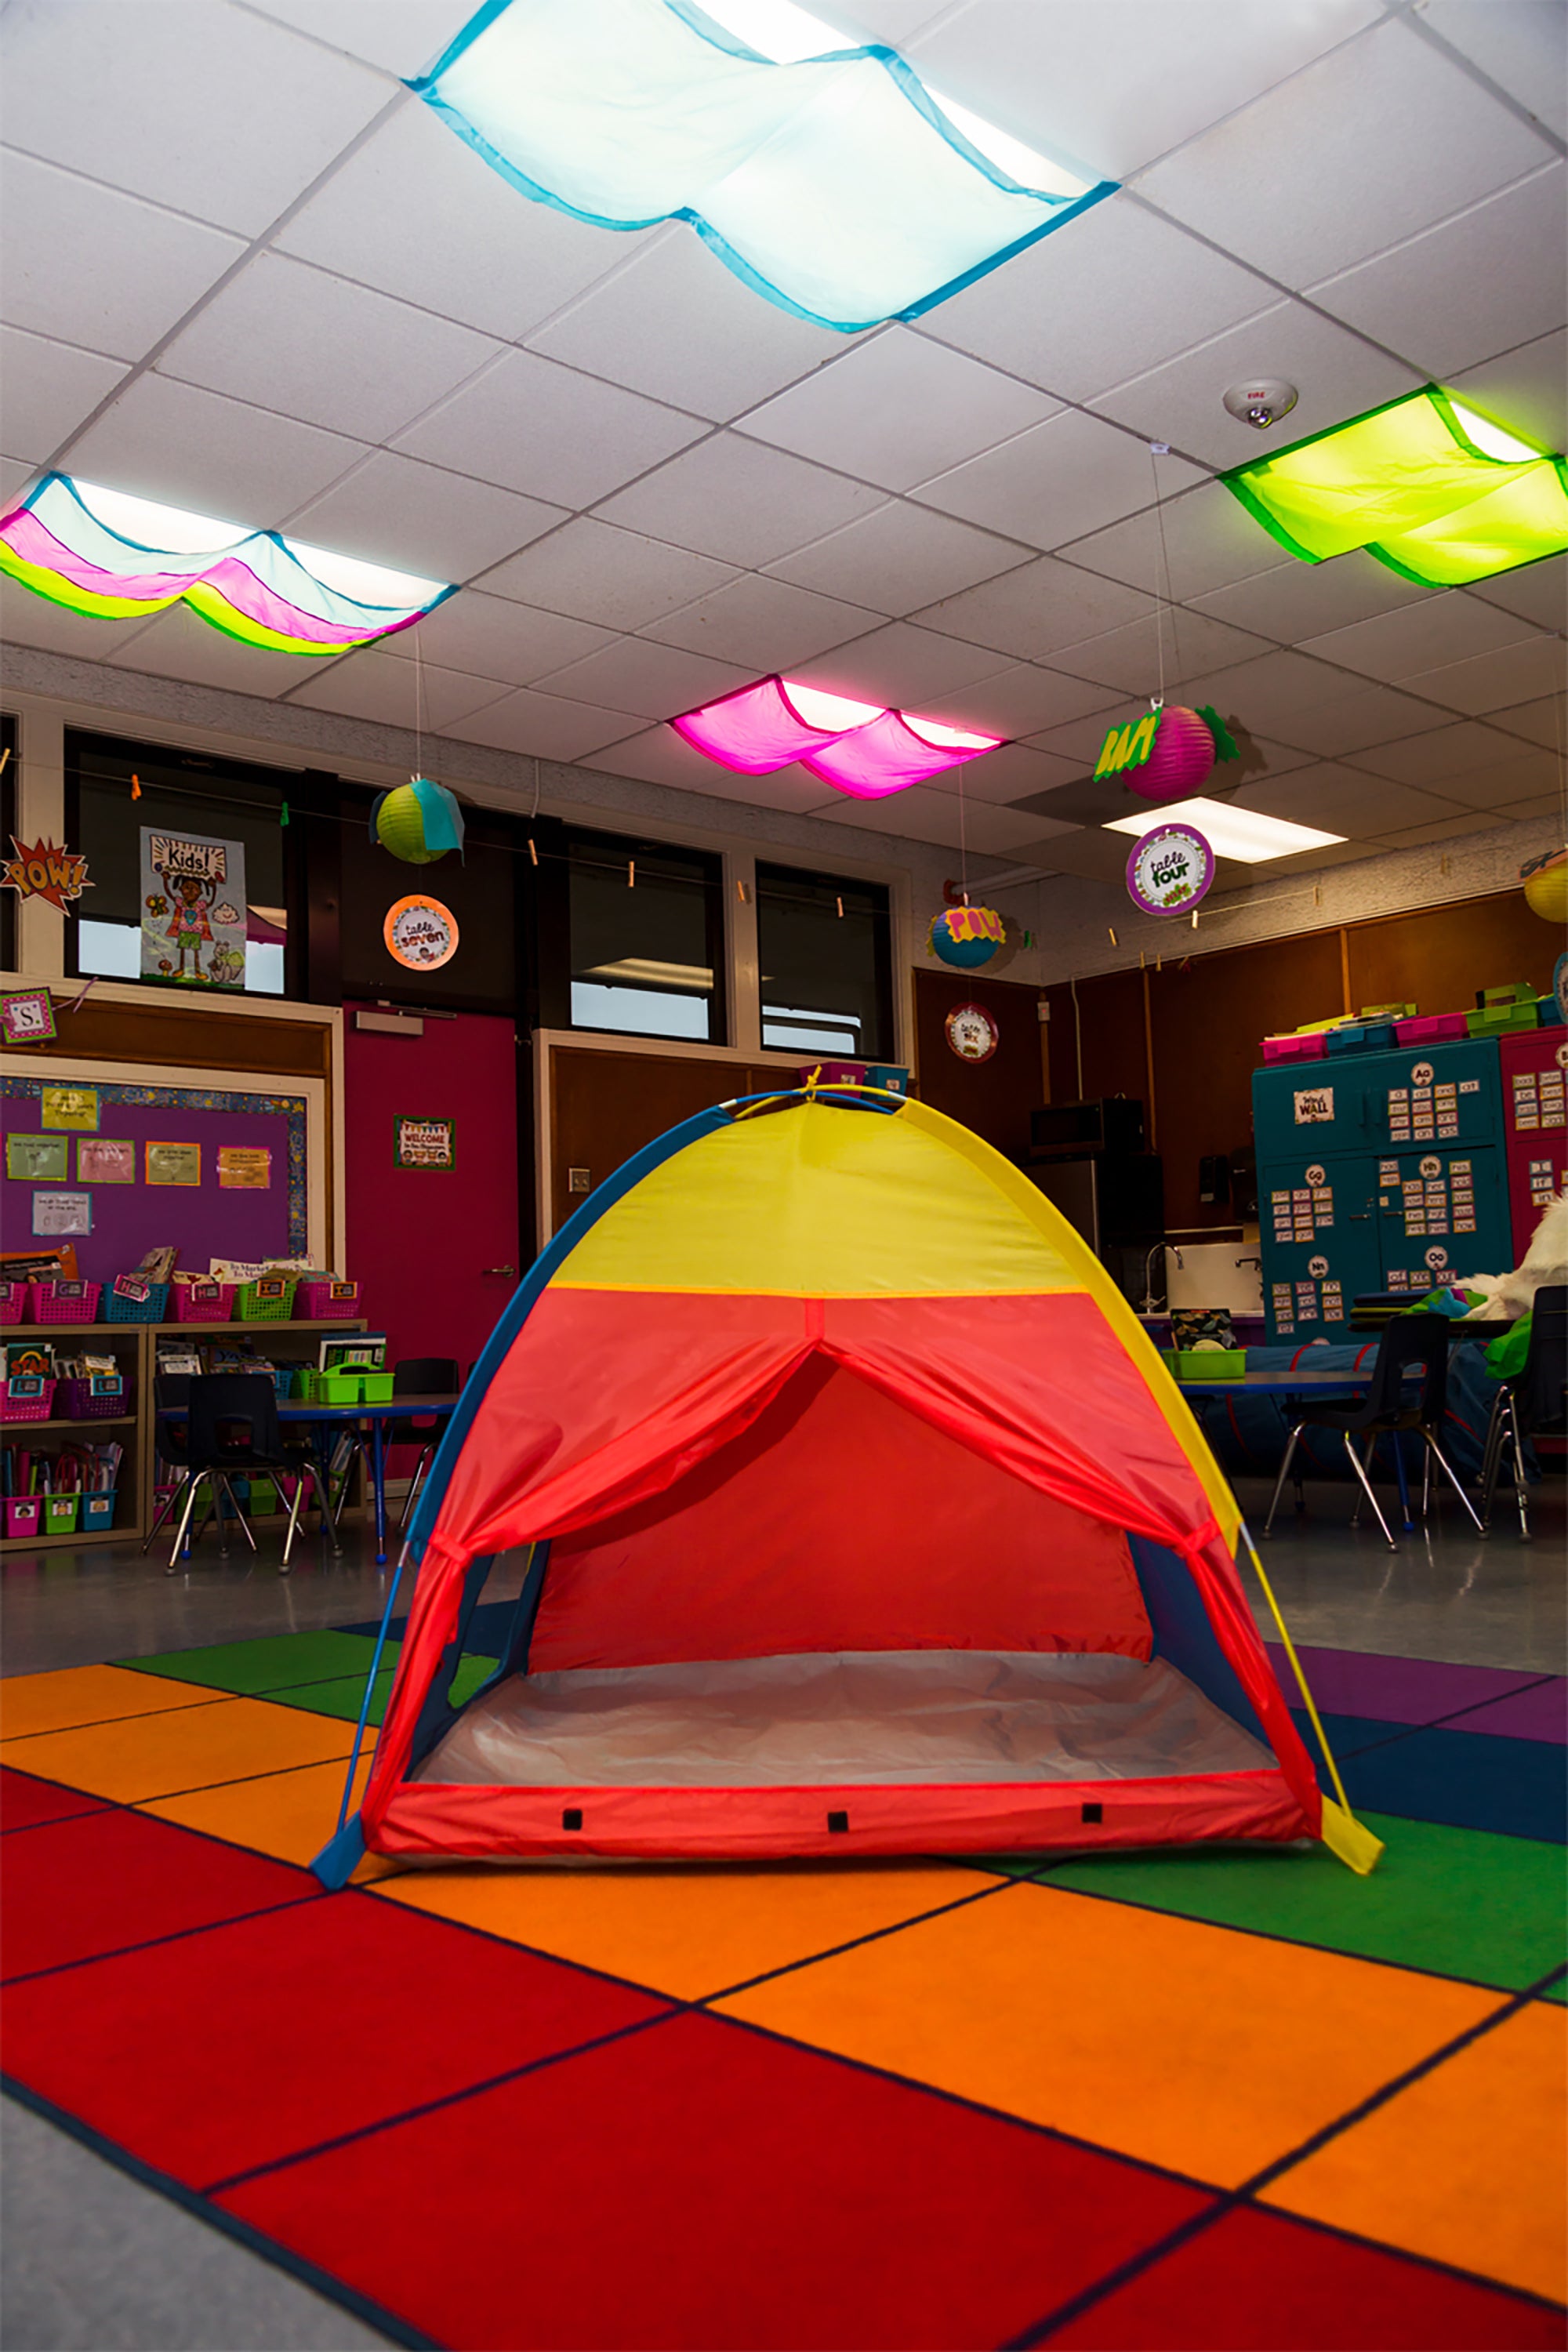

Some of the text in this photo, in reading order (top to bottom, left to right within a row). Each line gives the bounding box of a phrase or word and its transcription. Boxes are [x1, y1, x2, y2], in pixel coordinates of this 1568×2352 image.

[1095, 716, 1156, 775] BAM
[169, 848, 209, 873] Kids!
[1150, 851, 1185, 872] table
[9, 857, 85, 895] POW!
[1152, 862, 1189, 887] four
[406, 922, 434, 935] table
[949, 911, 1002, 938] POW
[401, 931, 445, 947] seven
[1300, 1102, 1328, 1115] WALL
[405, 1134, 445, 1143] WELCOME
[121, 1281, 132, 1294] H
[10, 1357, 50, 1375] STAR
